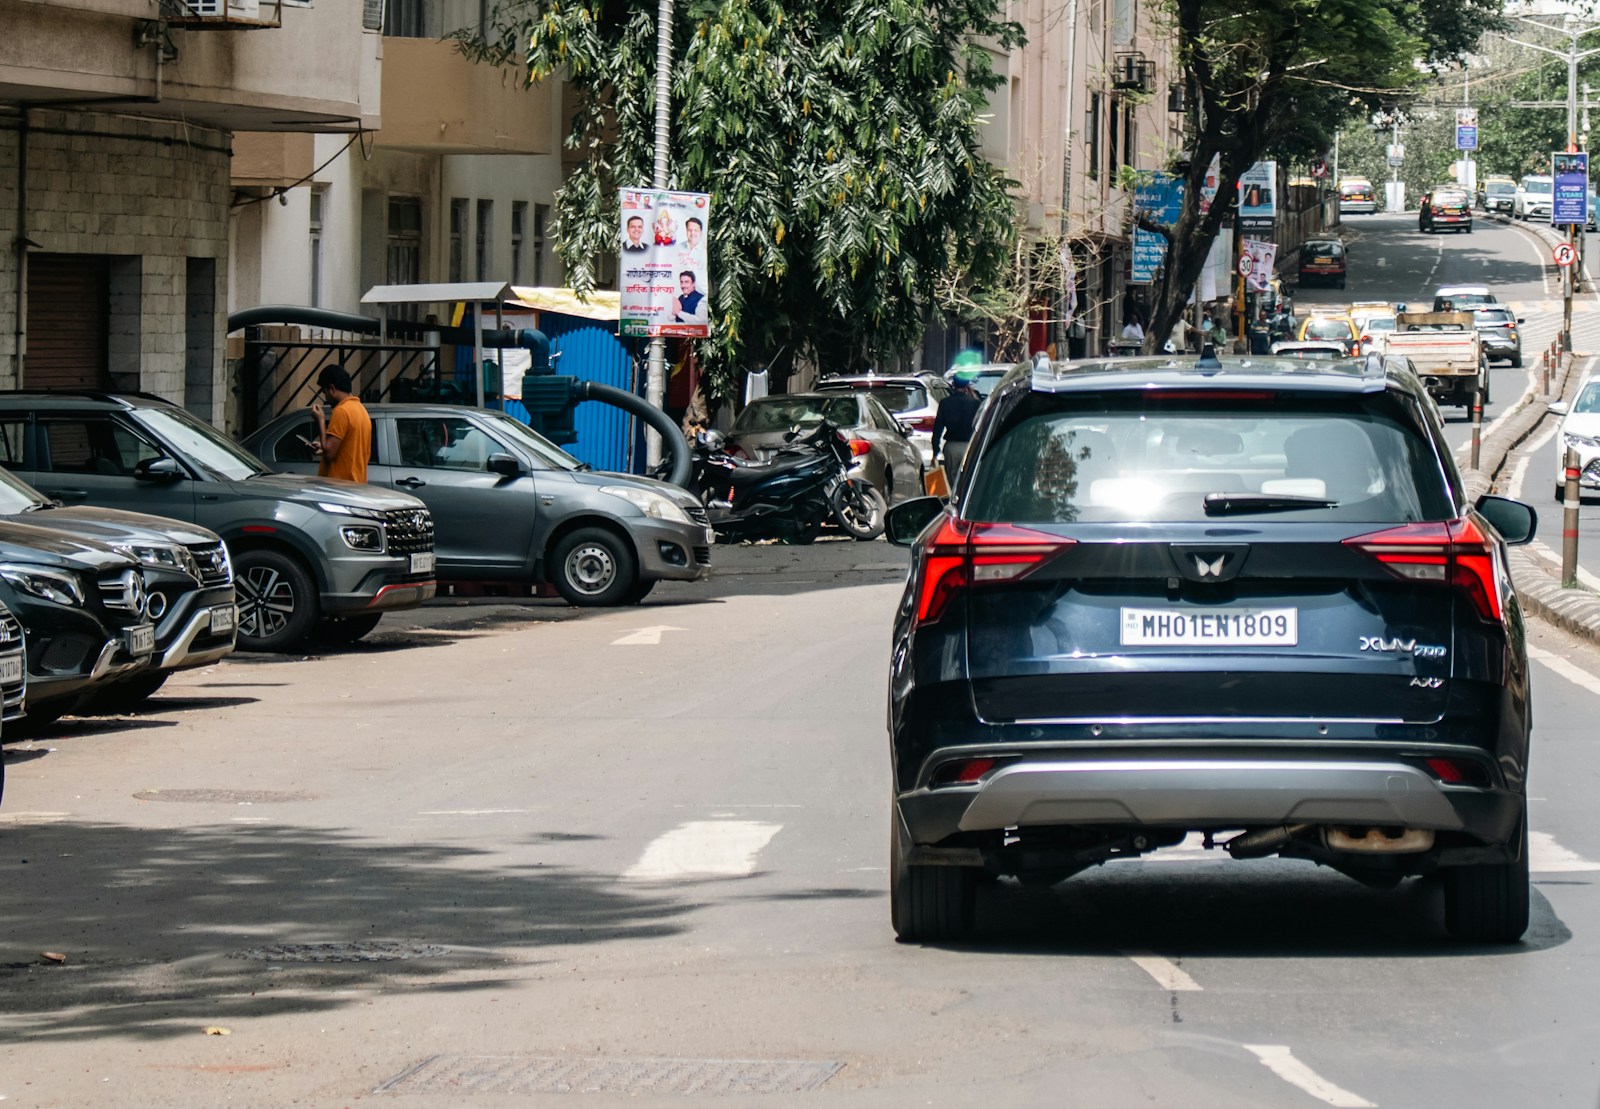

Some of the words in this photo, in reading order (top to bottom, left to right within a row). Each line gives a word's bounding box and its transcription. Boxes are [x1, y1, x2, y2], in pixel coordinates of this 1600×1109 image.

[1241, 260, 1251, 272] 30
[626, 284, 648, 293] हार्दिक
[624, 325, 661, 336] भाजपा
[1142, 615, 1288, 637] MH01EN1809
